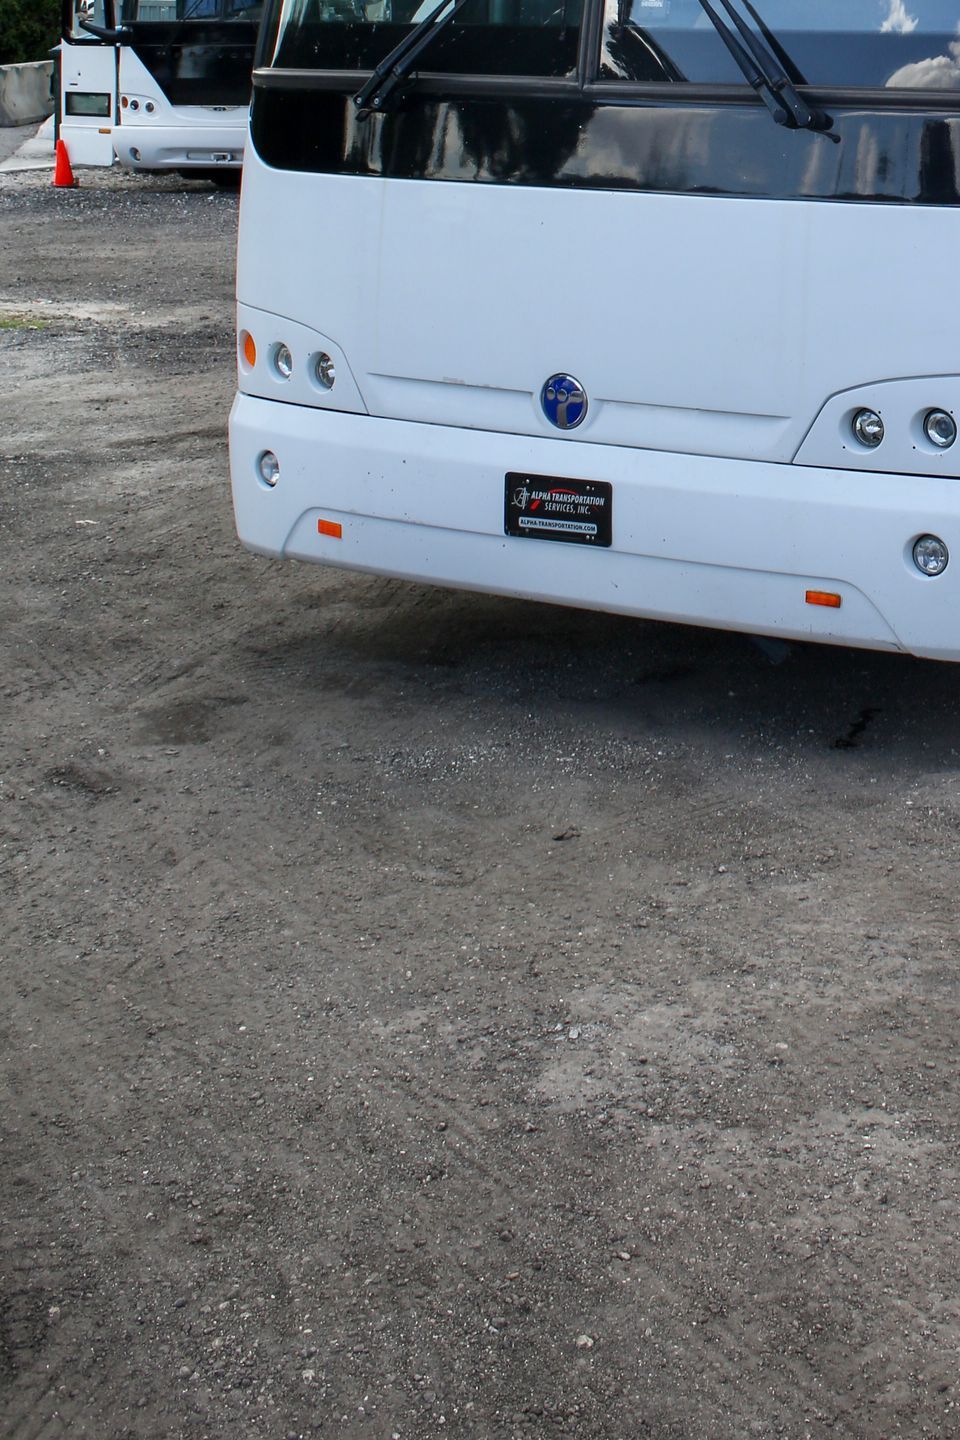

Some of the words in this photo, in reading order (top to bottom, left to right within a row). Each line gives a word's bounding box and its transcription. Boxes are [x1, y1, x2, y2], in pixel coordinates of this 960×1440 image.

[531, 490, 551, 501] ALPHA
[552, 492, 605, 506] TRANSPORTATION
[544, 502, 576, 514] SERVICES,
[577, 505, 591, 515] INC.
[520, 518, 596, 531] ALPHA-TRANSPORTATION.COM
